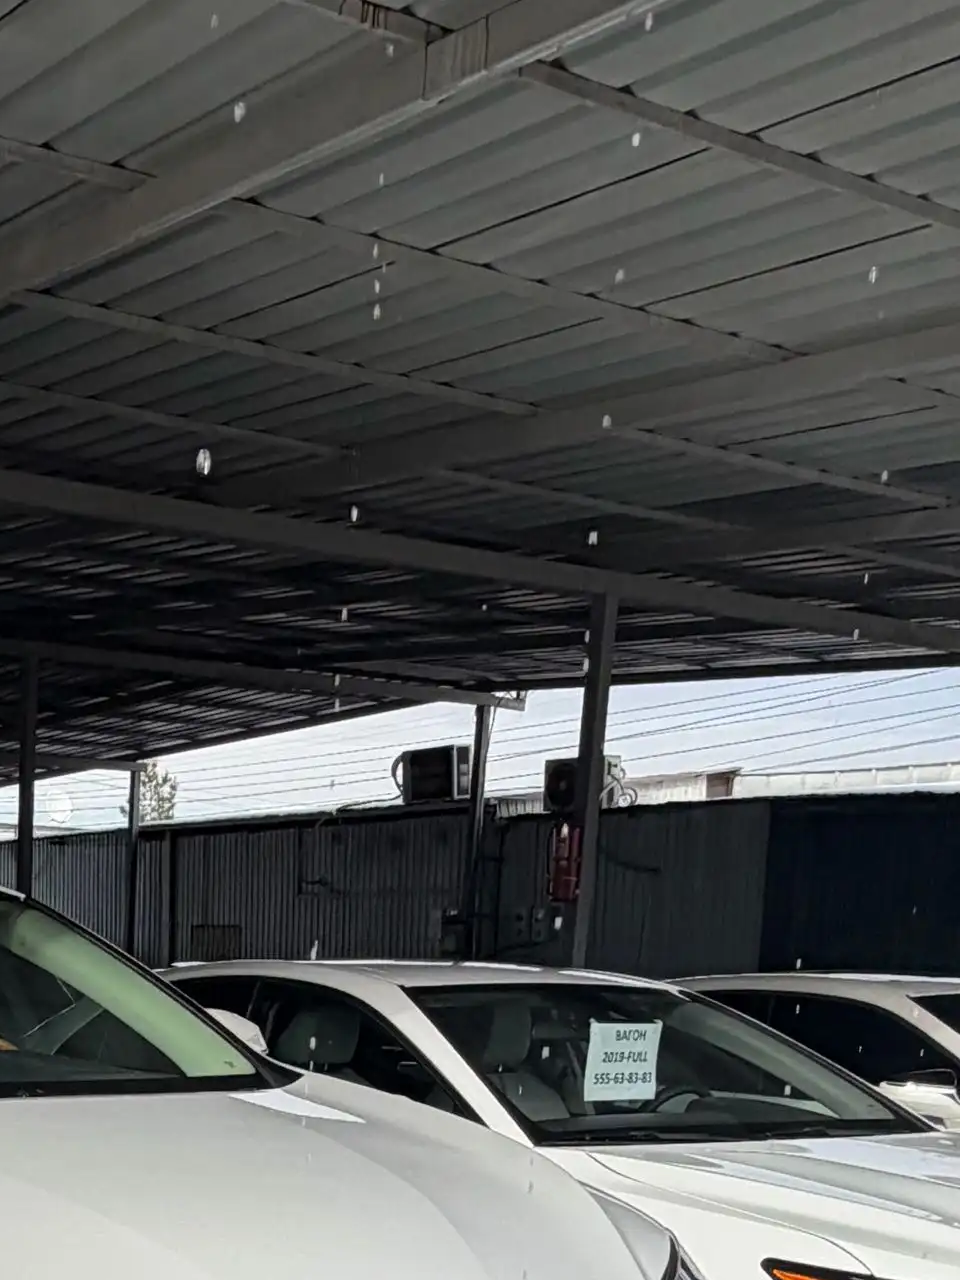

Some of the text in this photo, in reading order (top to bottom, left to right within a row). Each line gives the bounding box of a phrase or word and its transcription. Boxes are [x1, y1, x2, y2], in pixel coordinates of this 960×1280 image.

[615, 1029, 648, 1042] ВАГОН
[602, 1051, 648, 1064] 2019-FULL
[593, 1072, 653, 1085] 555-63-83-83
